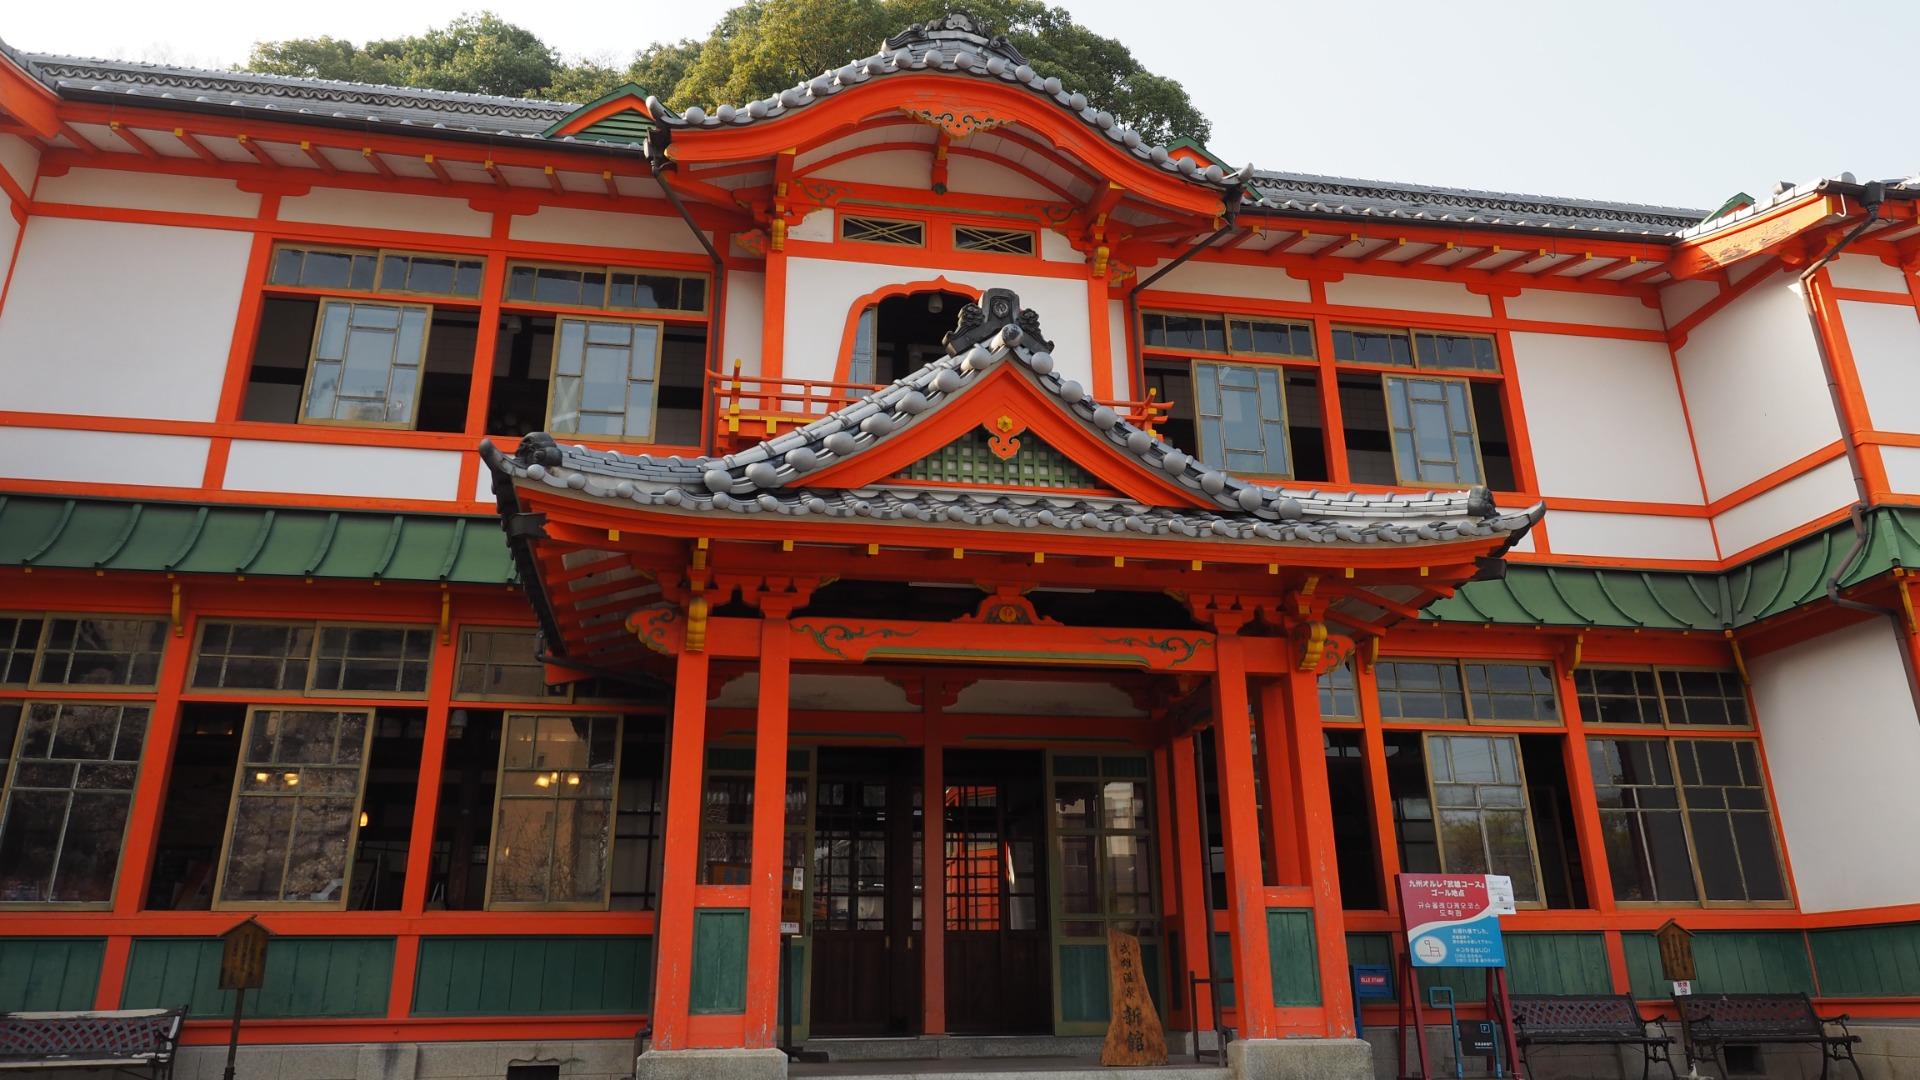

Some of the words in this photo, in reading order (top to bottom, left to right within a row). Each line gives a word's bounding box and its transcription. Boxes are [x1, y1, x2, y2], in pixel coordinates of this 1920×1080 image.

[1431, 889, 1465, 897] ゴール地点
